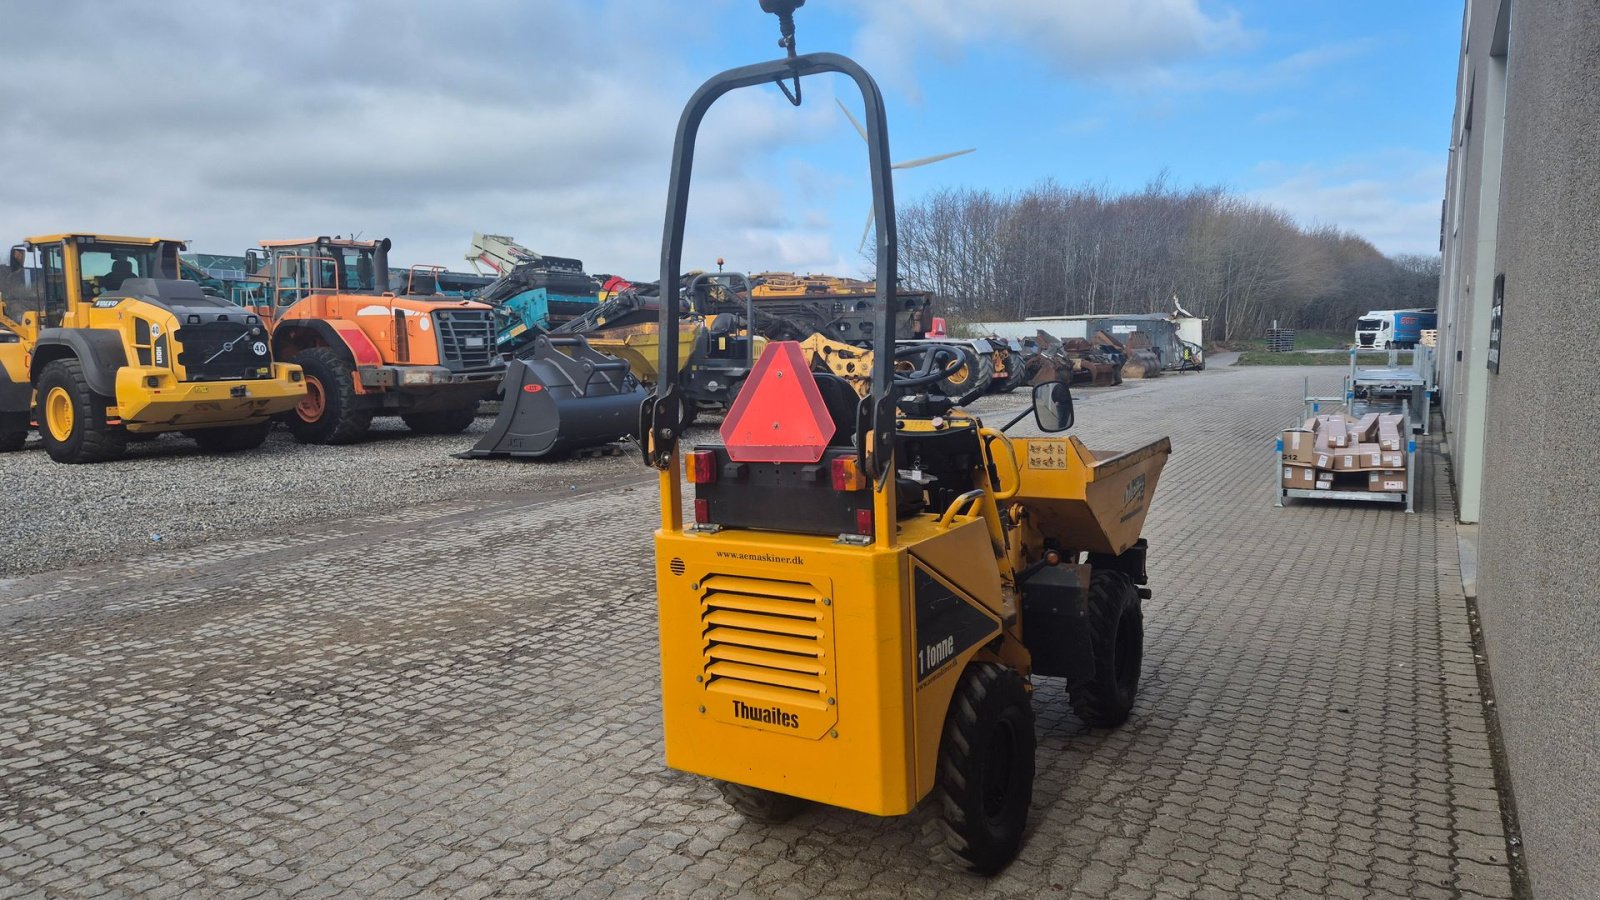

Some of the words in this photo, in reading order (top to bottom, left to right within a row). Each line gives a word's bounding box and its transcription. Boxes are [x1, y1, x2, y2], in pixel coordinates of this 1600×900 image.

[95, 300, 118, 308] VOLVO
[254, 345, 266, 353] 40
[716, 551, 804, 565] www.aemaskiner.dk
[918, 649, 924, 675] 1
[926, 635, 954, 670] tonne
[732, 700, 799, 729] Thwaites
